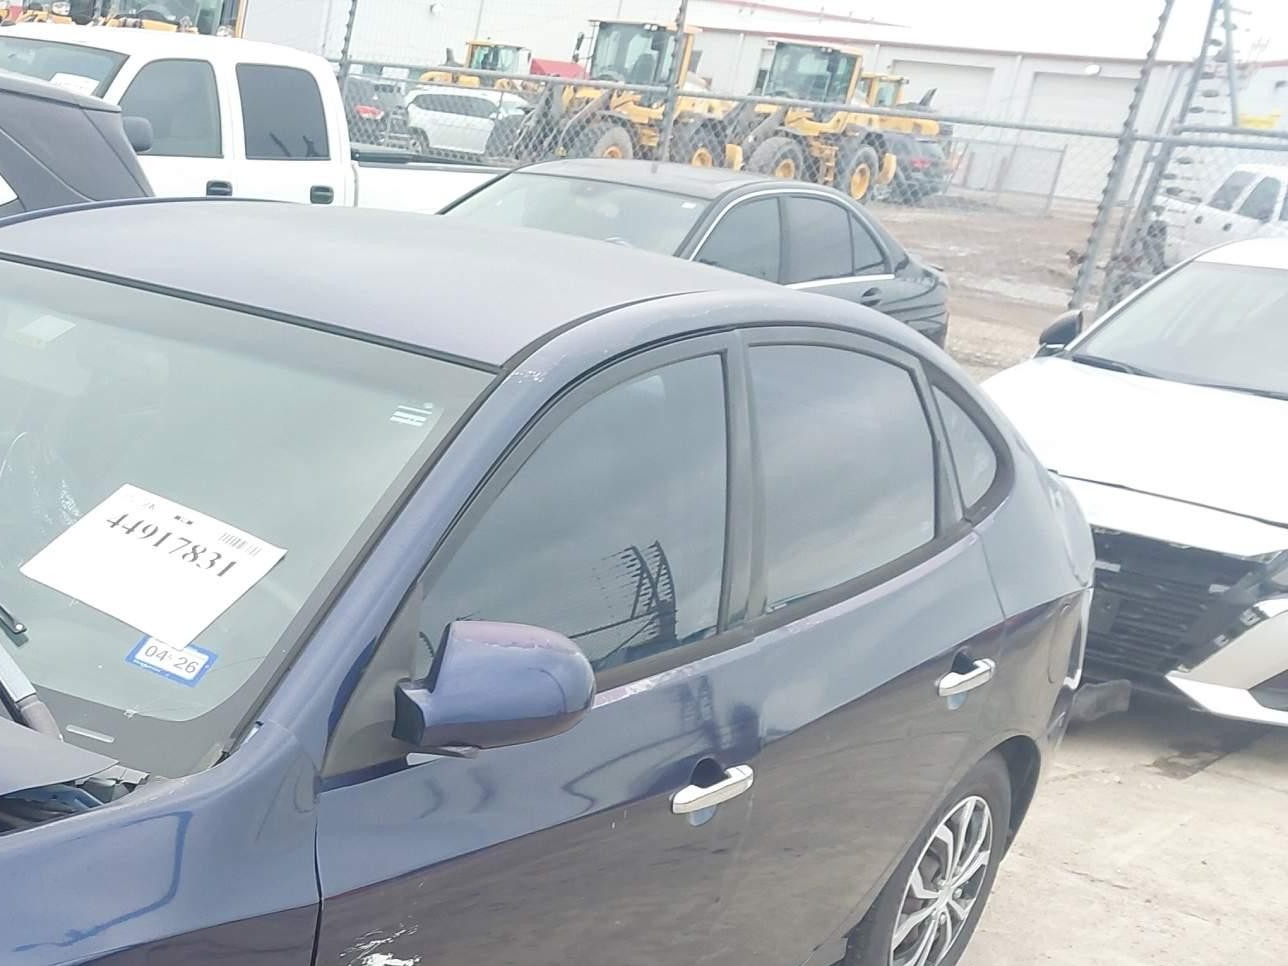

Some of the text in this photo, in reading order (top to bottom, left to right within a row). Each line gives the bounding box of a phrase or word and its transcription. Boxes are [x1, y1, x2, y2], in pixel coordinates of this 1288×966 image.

[106, 513, 237, 577] 44917831
[144, 645, 169, 662] 04
[173, 656, 200, 674] 26
